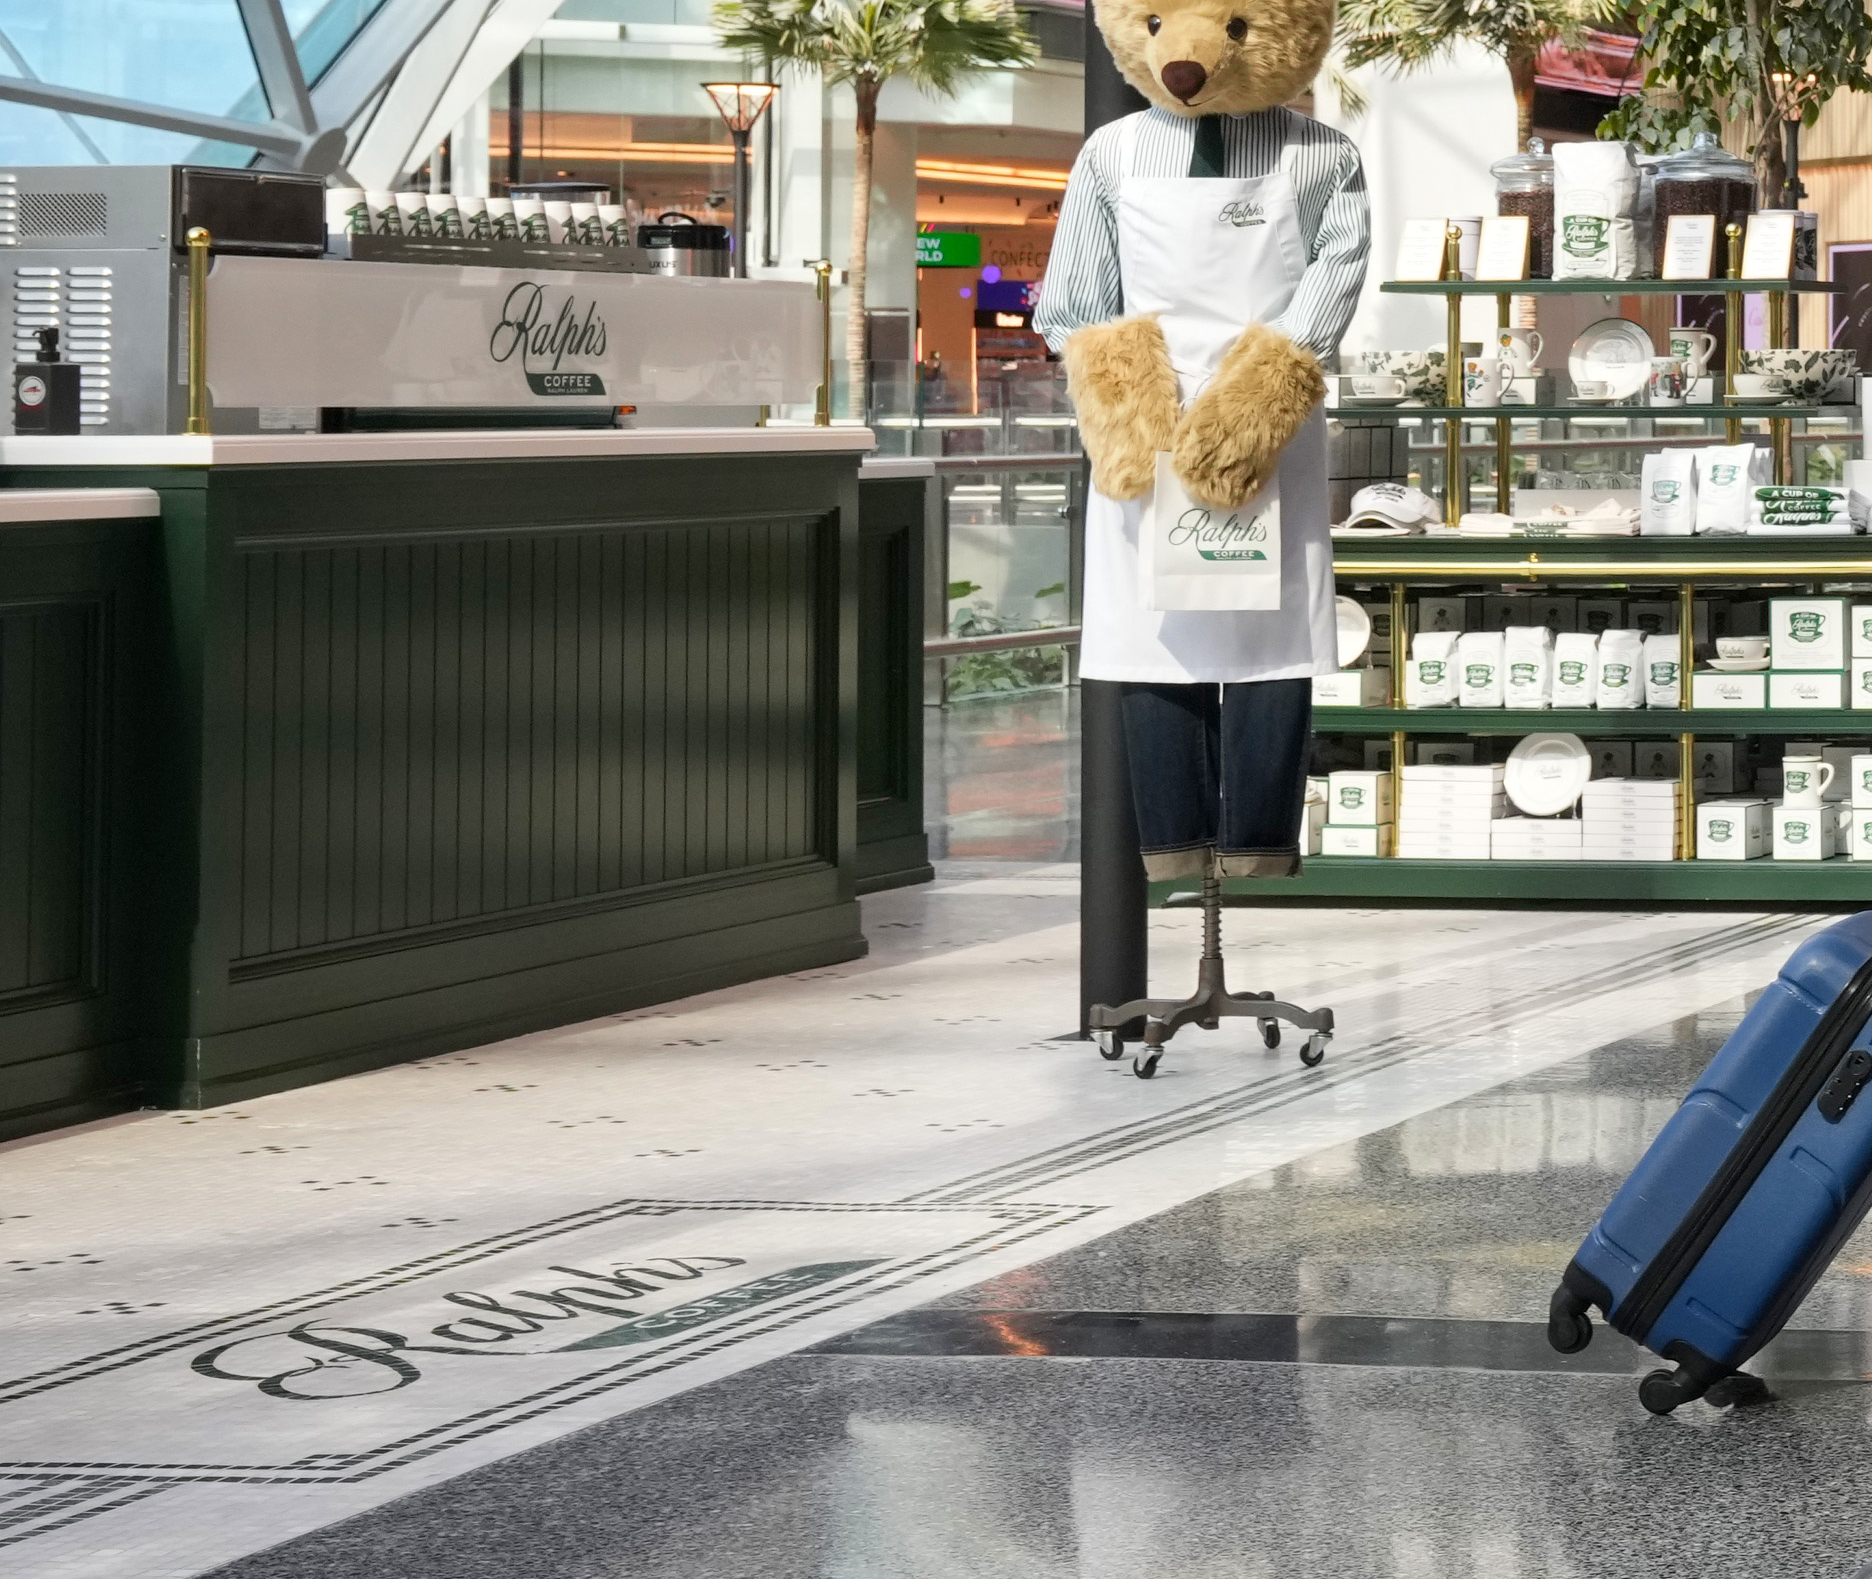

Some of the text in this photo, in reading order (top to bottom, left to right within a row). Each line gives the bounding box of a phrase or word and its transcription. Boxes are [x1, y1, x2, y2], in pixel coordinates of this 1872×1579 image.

[490, 280, 607, 372] Ralph's
[543, 375, 592, 387] COFFEE
[1771, 490, 1779, 498] A
[1781, 490, 1803, 498] CUP
[1168, 508, 1267, 549] Ralph's
[632, 1273, 815, 1330] COFFEE
[190, 1253, 748, 1402] Ralph's
